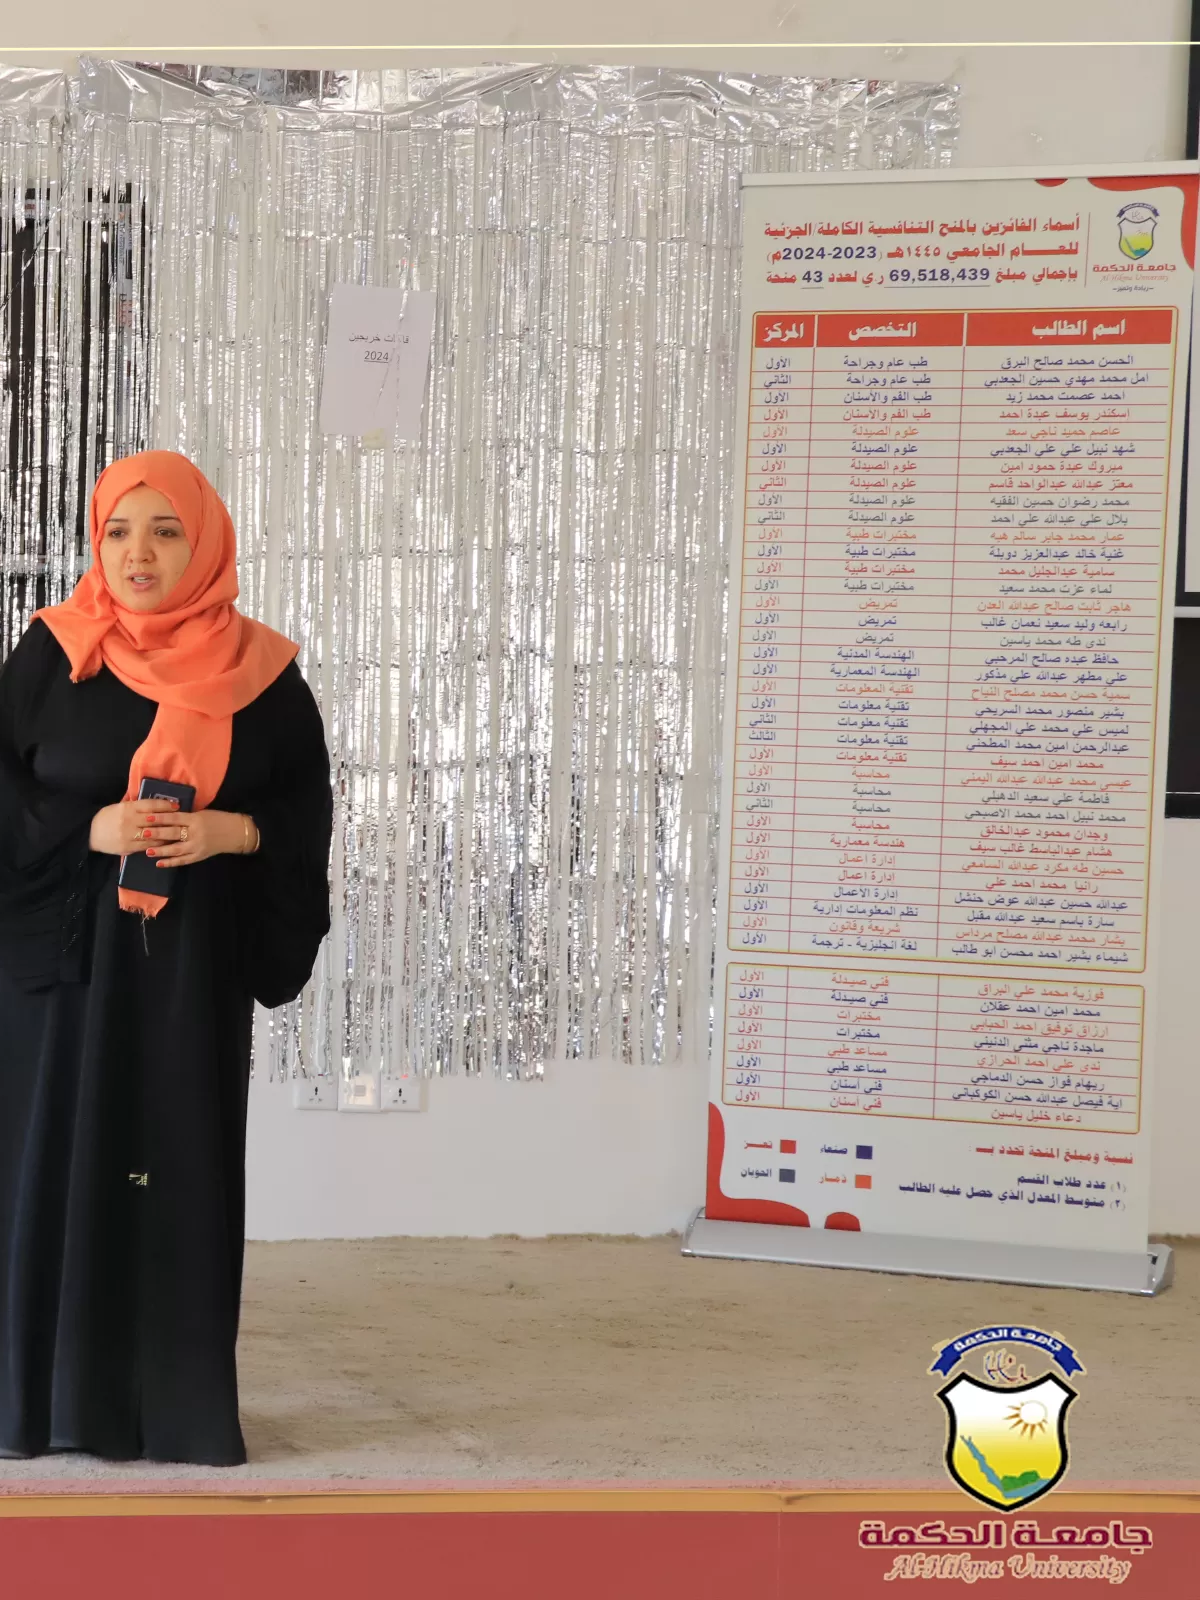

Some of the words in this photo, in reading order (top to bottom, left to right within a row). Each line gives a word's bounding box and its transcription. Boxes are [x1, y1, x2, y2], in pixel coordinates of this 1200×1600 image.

[868, 221, 934, 237] التنافسية
[939, 220, 976, 237] بالمنح
[982, 217, 1037, 237] الفائزين
[1042, 213, 1080, 235] أسماء
[946, 243, 1004, 261] الجامعي
[1092, 263, 1134, 272] الحكمة
[1136, 263, 1176, 272] جامعة
[766, 270, 797, 284] منحة
[802, 268, 823, 284] 43
[828, 270, 857, 284] لعدد
[889, 267, 991, 284] 69,518,439
[995, 269, 1028, 287] مبلغ
[1033, 268, 1079, 287] بإجمالي
[763, 321, 804, 342] المركز
[848, 320, 916, 341] التخصص
[1032, 320, 1087, 338] الطالب
[1093, 319, 1126, 336] اسم
[364, 350, 389, 361] 2024
[909, 356, 928, 367] طب
[1067, 358, 1094, 366] محمد
[843, 356, 884, 369] وجراحة
[887, 357, 904, 369] عام
[1034, 356, 1063, 370] صالح
[849, 494, 887, 505] الصيدلة
[891, 496, 916, 508] علوم
[1102, 498, 1130, 506] محمد
[1076, 761, 1104, 769] محمد
[1073, 1008, 1100, 1017] محمد
[820, 1144, 848, 1154] صنعاء
[1028, 1146, 1059, 1159] المنحة
[1104, 1152, 1133, 1164] نسبة
[1017, 1174, 1048, 1187] القسم
[1086, 1179, 1106, 1190] عدد
[899, 1183, 935, 1194] الطالب
[997, 1190, 1023, 1203] الذي
